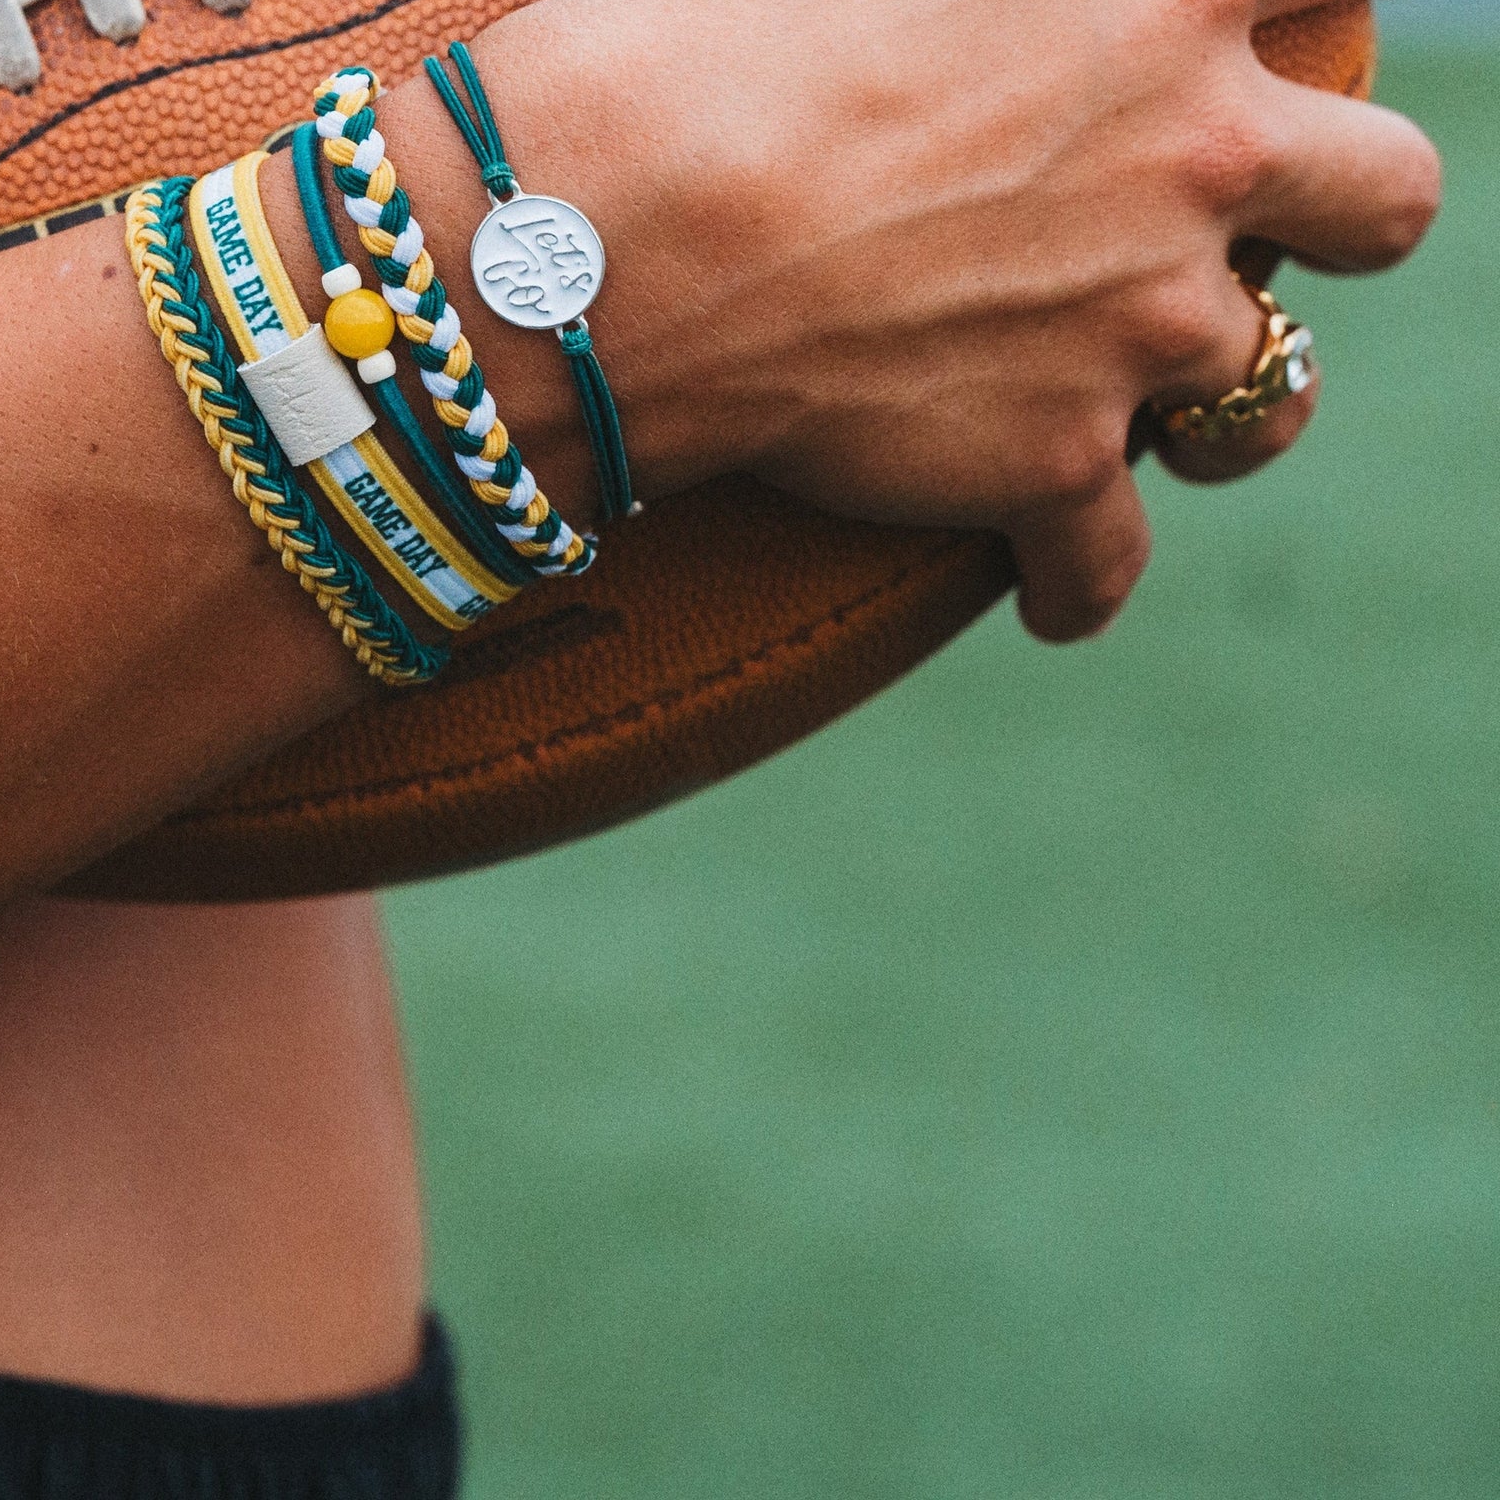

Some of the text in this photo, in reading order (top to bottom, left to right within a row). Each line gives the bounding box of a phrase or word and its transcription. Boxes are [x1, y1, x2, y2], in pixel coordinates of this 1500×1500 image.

[206, 196, 284, 337] GAME DAY
[483, 260, 550, 314] Go
[344, 472, 450, 578] GAME DAY
